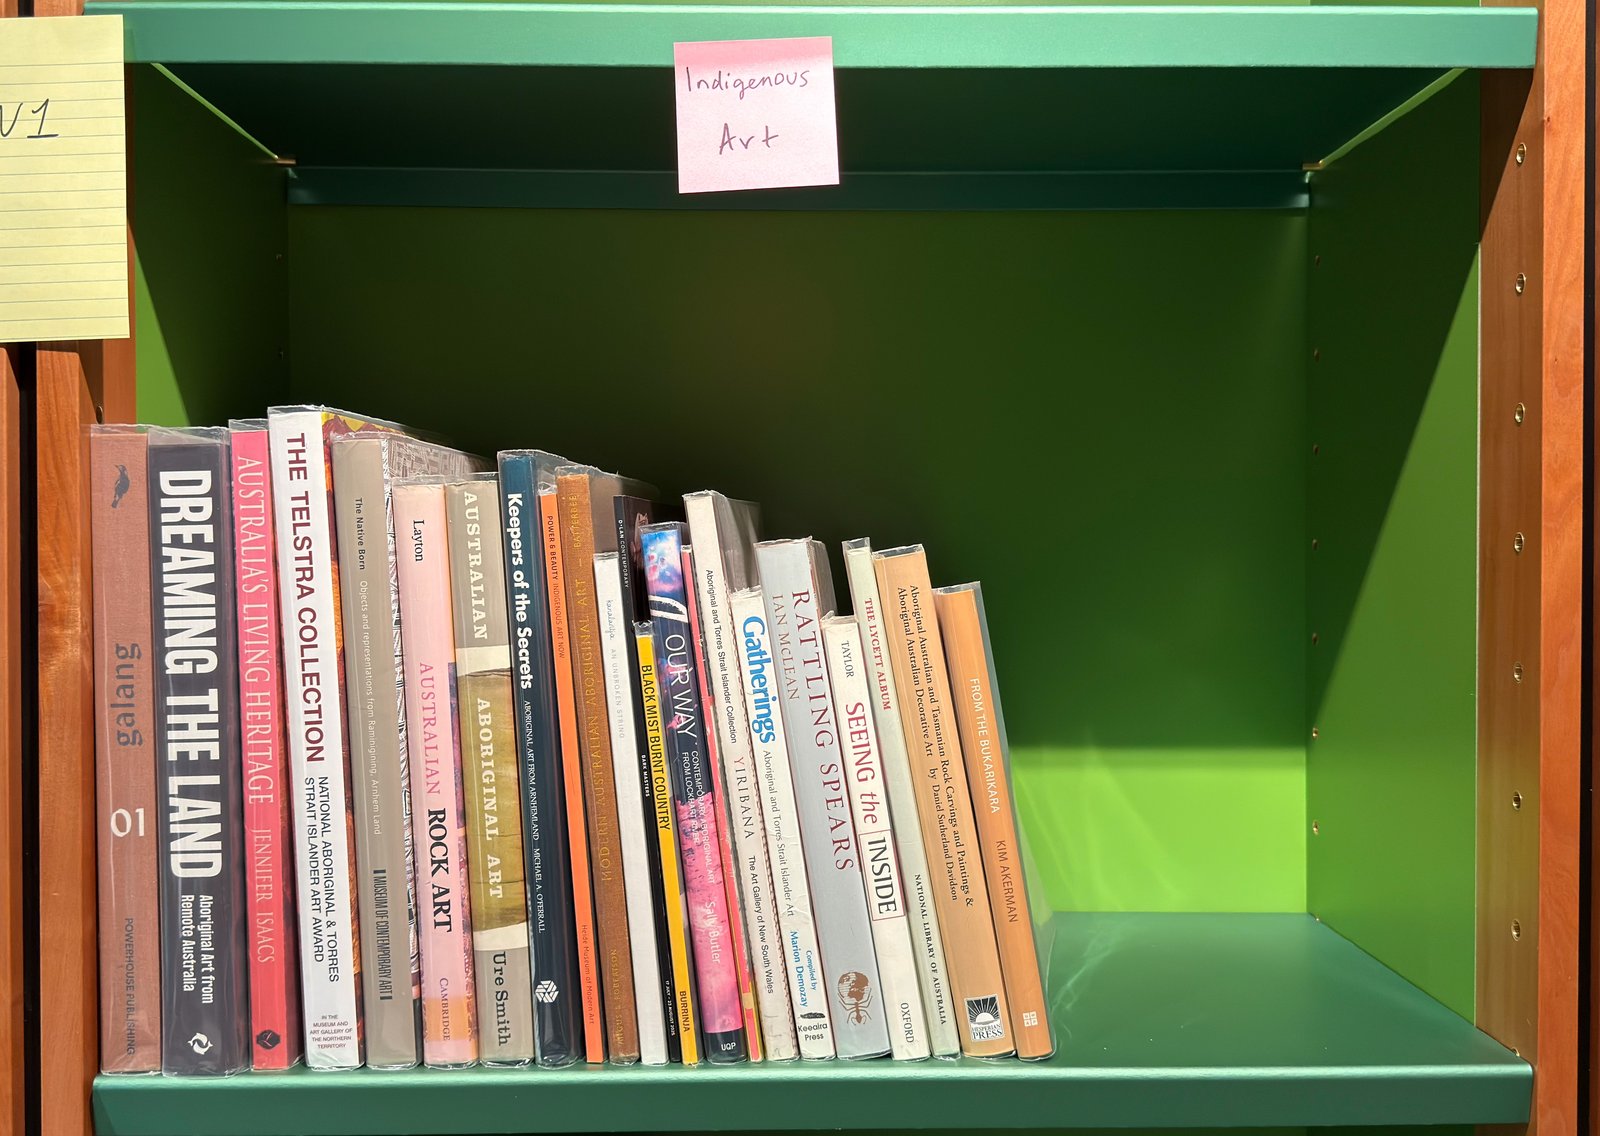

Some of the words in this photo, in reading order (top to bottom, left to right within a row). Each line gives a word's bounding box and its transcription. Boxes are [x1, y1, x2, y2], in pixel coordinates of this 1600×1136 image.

[686, 66, 810, 100] Indigenous
[719, 122, 779, 155] Art
[286, 432, 308, 481] THE
[237, 456, 267, 593] AUSTRALIA'S
[354, 497, 363, 514] The
[568, 495, 581, 548] BATTERBEE
[290, 491, 314, 599] TELSTRA
[355, 516, 365, 546] Native
[410, 519, 424, 562] Layton
[506, 493, 523, 565] Keepers
[546, 515, 555, 542] POWER
[160, 470, 216, 674] DREAMING
[357, 548, 366, 570] Born
[464, 492, 487, 638] AUSTRALIAN
[512, 570, 529, 589] of
[549, 550, 558, 580] BEAUTY
[619, 540, 629, 587] CONTEMPORARY
[358, 579, 369, 609] Objects
[514, 592, 531, 622] the
[574, 578, 588, 606] ART
[705, 569, 718, 608] Aboriginal
[361, 613, 370, 630] and
[711, 608, 720, 624] and
[771, 594, 788, 625] IAN
[864, 597, 875, 622] THE
[909, 585, 926, 634] Aboriginal
[242, 603, 270, 682] LIVING
[516, 626, 533, 689] Secrets
[713, 625, 723, 650] Torres
[868, 624, 884, 667] LYCETT
[361, 631, 373, 695] representations
[578, 615, 596, 705] ABORIGINAL
[664, 634, 689, 685] OUR
[717, 650, 727, 672] Strait
[840, 640, 854, 677] TAYLOR
[897, 587, 913, 636] Aboriginal
[906, 638, 920, 686] Australian
[914, 688, 930, 739] Decorative
[923, 740, 933, 757] Art
[918, 636, 933, 684] Australian
[110, 642, 142, 746] galang
[297, 607, 324, 761] COLLECTION
[641, 664, 656, 703] BLACK
[720, 673, 731, 704] Islander
[742, 616, 776, 743] Gatherings
[876, 671, 891, 710] ALBUM
[927, 686, 939, 704] and
[969, 677, 984, 712] FROM
[166, 688, 219, 761] THE
[366, 697, 375, 718] from
[523, 700, 533, 746] ABORIGINAL
[645, 704, 659, 733] MIST
[672, 688, 697, 737] WAY
[725, 705, 737, 744] Collection
[976, 713, 988, 736] THE
[245, 691, 273, 803] HERITAGE
[419, 663, 440, 794] AUSTRALIAN
[791, 590, 834, 747] RATTLING
[819, 763, 854, 870] SPEARS
[845, 702, 875, 782] SEEING
[931, 705, 945, 757] Tasmanian
[477, 698, 498, 840] ABORIGINAL
[526, 747, 535, 762] ART
[527, 763, 536, 785] FROM
[587, 715, 605, 805] AUSTRALIAN
[649, 735, 664, 774] BURNT
[762, 749, 778, 794] Aboriginal
[927, 767, 938, 780] by
[940, 759, 953, 784] Rock
[371, 778, 380, 811] Arnhem
[979, 739, 1000, 813] BUKARIKARA
[304, 776, 317, 820] STRAIT
[318, 776, 331, 837] NATIONAL
[529, 786, 539, 841] ARNHEMLAND
[653, 776, 670, 830] COUNTRY
[691, 750, 706, 816] CONTEMPORARY
[699, 818, 712, 867] ABORIGINAL
[706, 868, 715, 883] ART
[733, 756, 754, 839] YIRIBANA
[769, 795, 780, 812] and
[859, 791, 880, 824] the
[931, 783, 944, 812] Daniel
[945, 785, 957, 828] Carvings
[110, 807, 145, 838] 01
[168, 775, 222, 878] LAND
[372, 814, 382, 835] Land
[427, 808, 449, 876] ROCK
[772, 814, 783, 841] Torres
[937, 813, 953, 859] Sutherland
[952, 829, 964, 847] and
[252, 829, 273, 902] JENNIFER
[306, 824, 320, 885] ISLANDER
[533, 847, 542, 883] MICHAEL
[596, 816, 612, 881] MODERN
[748, 855, 756, 871] The
[776, 842, 788, 865] Strait
[995, 839, 1008, 862] KIM
[321, 840, 335, 916] ABORIGINAL
[373, 875, 388, 908] MUSEUM
[486, 854, 503, 898] ART
[535, 883, 542, 892] A.
[750, 872, 758, 884] Art
[780, 867, 792, 900] Islander
[867, 837, 897, 914] INSIDE
[945, 861, 958, 900] Davidson
[956, 849, 969, 895] Paintings
[310, 888, 322, 913] ART
[374, 909, 389, 919] OF
[431, 883, 452, 932] ART
[751, 885, 762, 914] Gallery
[785, 900, 794, 916] Art
[964, 896, 974, 907] &
[999, 865, 1018, 922] AKERMAN
[180, 894, 195, 936] Remote
[196, 894, 214, 951] Aboriginal
[325, 919, 337, 928] &
[699, 900, 717, 927] Sally
[708, 930, 721, 963] Butler
[756, 914, 765, 923] of
[757, 924, 766, 942] New
[124, 917, 134, 991] POWERHOUSE
[256, 911, 275, 963] ISAACS
[311, 916, 324, 962] AWARD
[326, 932, 339, 982] TORRES
[375, 920, 391, 978] CONTEMPORARY
[760, 943, 771, 967] South
[181, 939, 197, 991] Australia
[200, 953, 215, 972] Art
[492, 950, 507, 986] Ure
[764, 968, 774, 993] Wales
[789, 930, 801, 963] Marion
[795, 965, 808, 1007] Demozay
[200, 974, 215, 1003] from
[378, 979, 393, 994] ART
[125, 993, 135, 1055] PUBLISHING
[439, 977, 450, 1040] CAMBRIDGE
[494, 989, 511, 1046] Smith
[678, 990, 690, 1032] BURRINJA
[900, 1002, 914, 1043] OXFORD
[804, 1033, 824, 1041] Press
[972, 1029, 1003, 1040] PRESS
